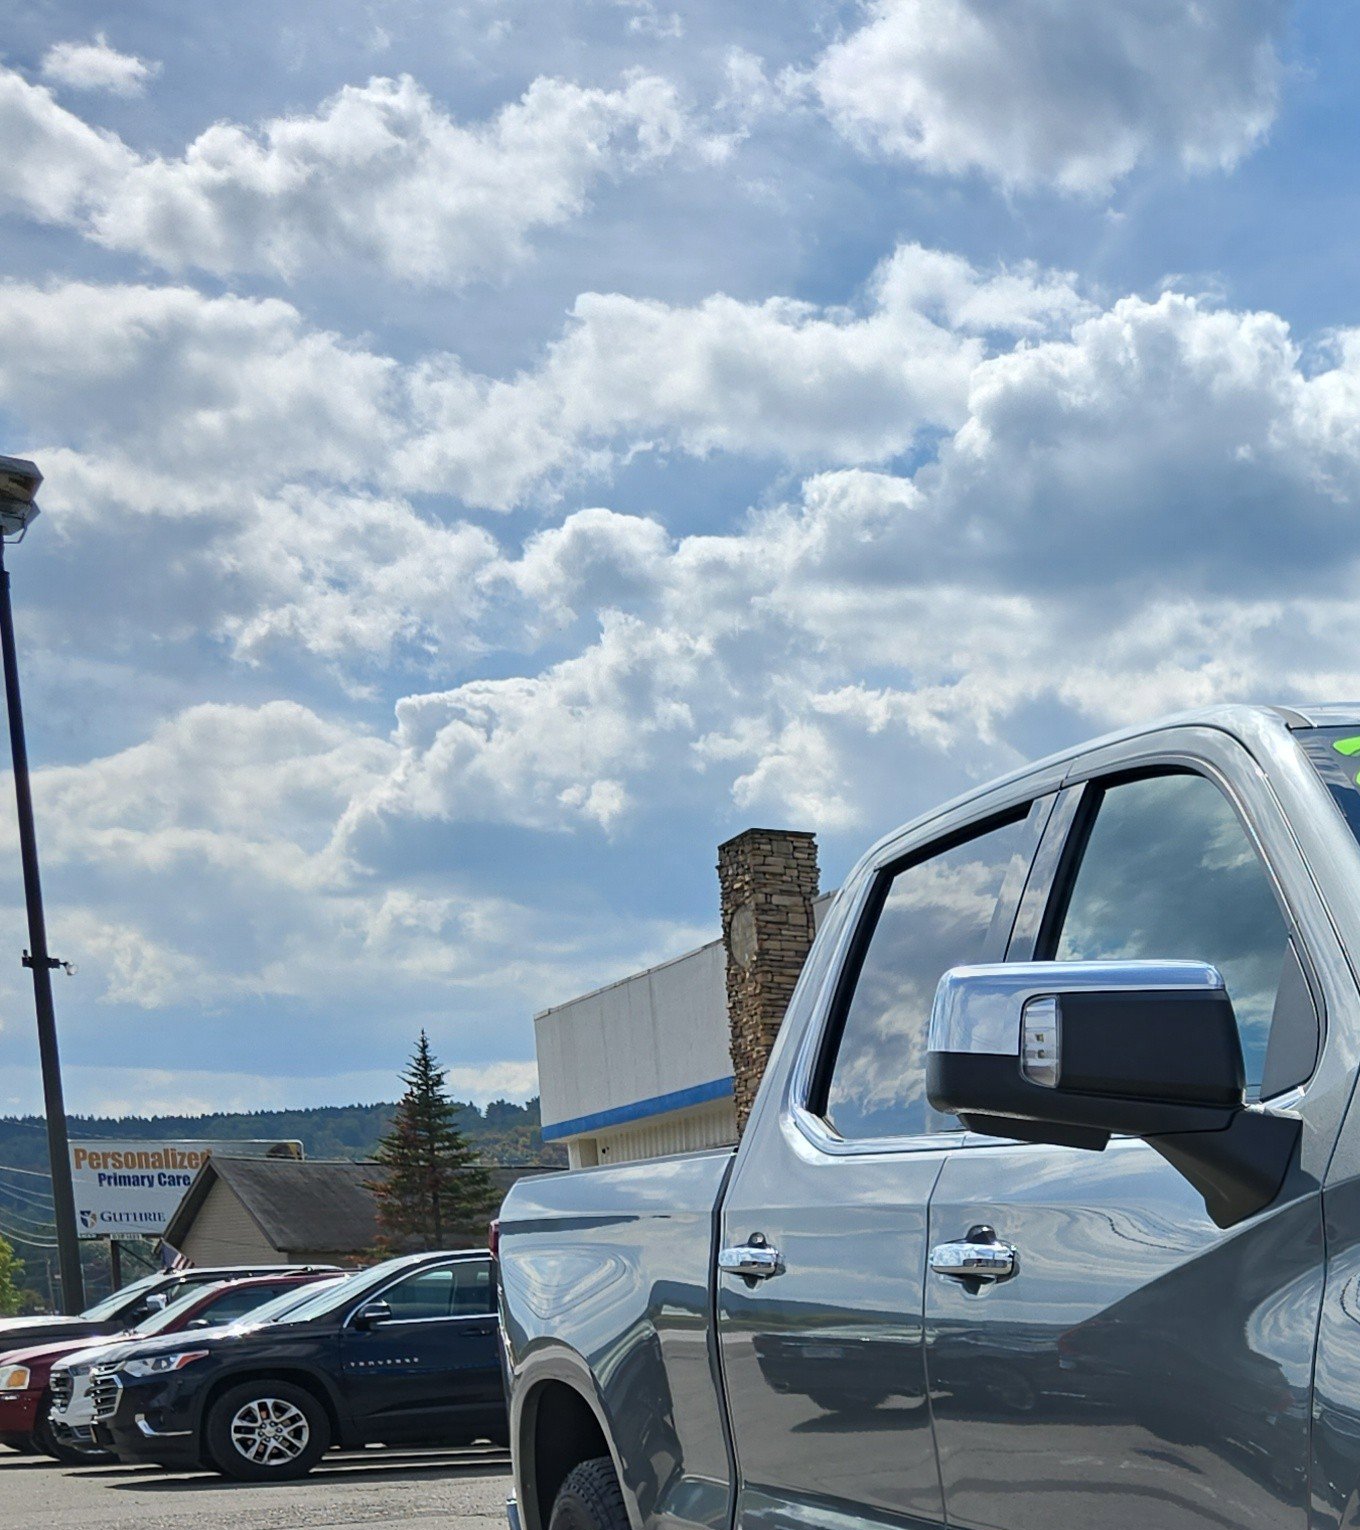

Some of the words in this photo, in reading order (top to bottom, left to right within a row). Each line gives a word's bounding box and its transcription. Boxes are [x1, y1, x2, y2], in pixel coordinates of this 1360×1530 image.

[98, 1172, 154, 1188] Primary
[157, 1172, 191, 1187] Care
[100, 1211, 166, 1223] GUTHRIE
